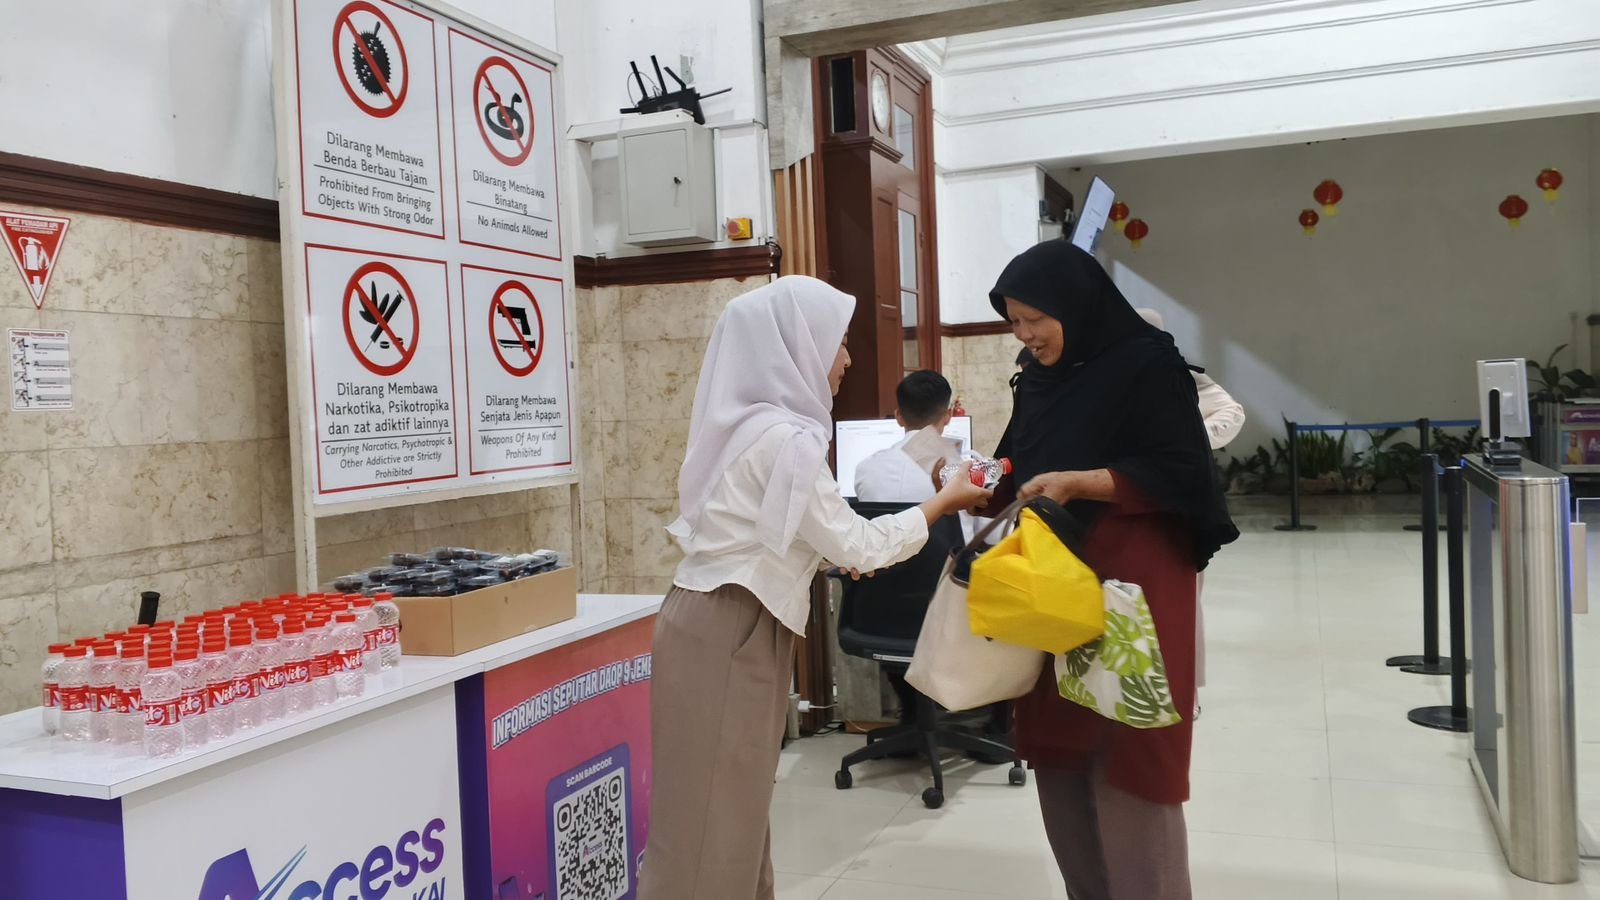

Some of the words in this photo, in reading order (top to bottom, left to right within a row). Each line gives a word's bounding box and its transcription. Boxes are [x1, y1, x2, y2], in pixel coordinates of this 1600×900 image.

[327, 131, 372, 158] Dilarang
[375, 144, 424, 167] Membawa
[324, 150, 357, 169] Benda
[361, 159, 396, 178] Berbau
[400, 168, 428, 187] Tajam
[320, 175, 369, 196] Prohibited
[372, 187, 394, 201] From
[397, 192, 431, 212] Bringing
[473, 169, 506, 191] Dilarang
[509, 180, 545, 198] Membawa
[318, 193, 355, 210] Objects
[358, 201, 380, 215] With
[383, 206, 411, 224] Strong
[414, 212, 434, 225] Odor
[495, 194, 528, 215] Binatang
[478, 215, 489, 226] No
[491, 218, 519, 233] Animals
[522, 225, 548, 239] Allowed
[337, 382, 384, 399] Dilarang
[388, 382, 438, 395] Membawa
[325, 401, 385, 416] Narkotika,
[388, 400, 449, 415] Psikotropika
[486, 395, 519, 408] Dilarang
[521, 395, 556, 405] Membawa
[328, 421, 349, 435] dan
[354, 421, 371, 433] zat
[375, 417, 411, 432] adiktif
[413, 417, 449, 432] lainnya
[481, 411, 510, 425] Senjata
[513, 409, 532, 421] Jenis
[535, 410, 561, 422] Apapun
[325, 445, 359, 457] Carrying
[402, 437, 445, 451] Psychotropic
[481, 435, 513, 447] Weapons
[515, 432, 524, 446] Of
[527, 433, 539, 444] Any
[542, 432, 556, 440] Kind
[340, 459, 363, 468] Other
[366, 455, 401, 466] Addictive
[403, 454, 414, 462] are
[417, 451, 442, 462] Strictly
[506, 447, 542, 459] Prohibited
[375, 467, 413, 479] Prohibited
[493, 688, 552, 749] INFORMASI
[552, 669, 599, 714] SEPUTAR
[598, 659, 624, 694] DAOP
[623, 658, 631, 685] 9
[566, 770, 585, 788] SCAN
[584, 756, 613, 779] BARCODE
